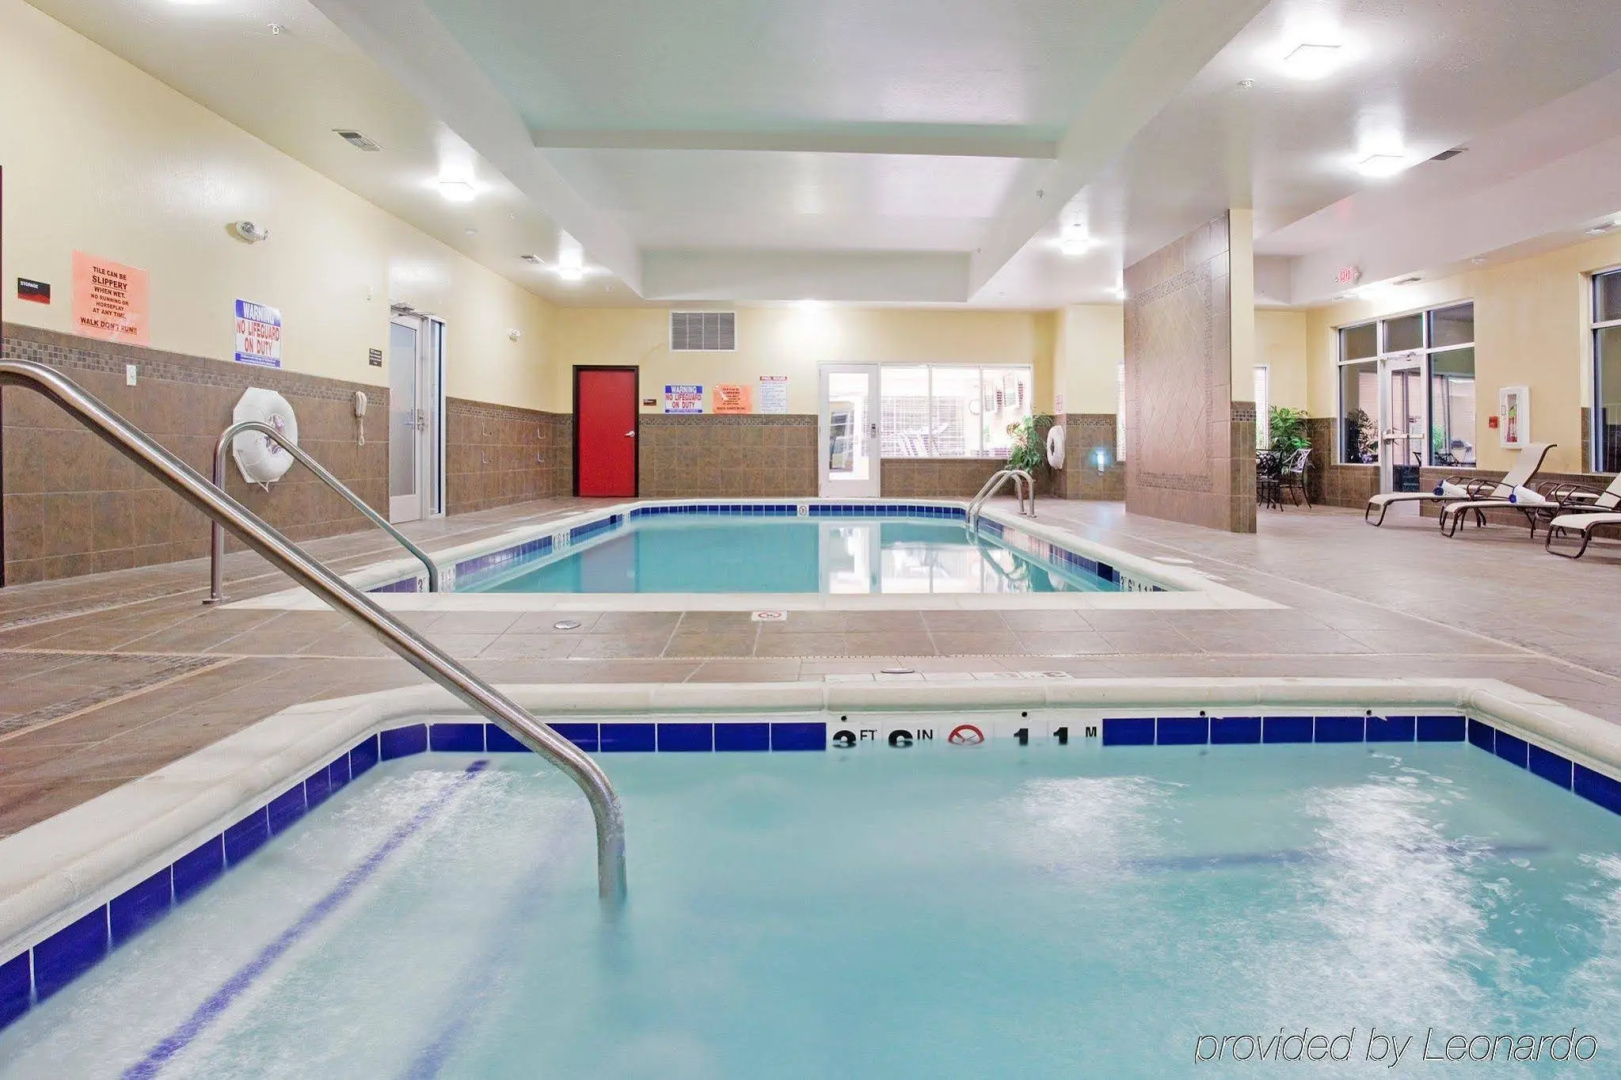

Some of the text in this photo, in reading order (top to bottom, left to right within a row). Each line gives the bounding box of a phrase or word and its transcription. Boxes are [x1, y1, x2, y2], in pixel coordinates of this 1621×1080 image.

[93, 266, 105, 275] TILE
[107, 270, 118, 278] CAN
[92, 275, 127, 290] SLIPPERY
[94, 286, 112, 295] WHEN
[96, 301, 124, 311] HORSEPLAY
[99, 295, 121, 304] RUNNING
[243, 301, 275, 325] WARNING
[80, 317, 99, 327] WALK
[236, 320, 280, 341] NO LIFEGUARD
[245, 337, 273, 356] ON DUTY
[860, 729, 877, 740] FT
[917, 729, 933, 740] IN
[1085, 726, 1097, 738] M
